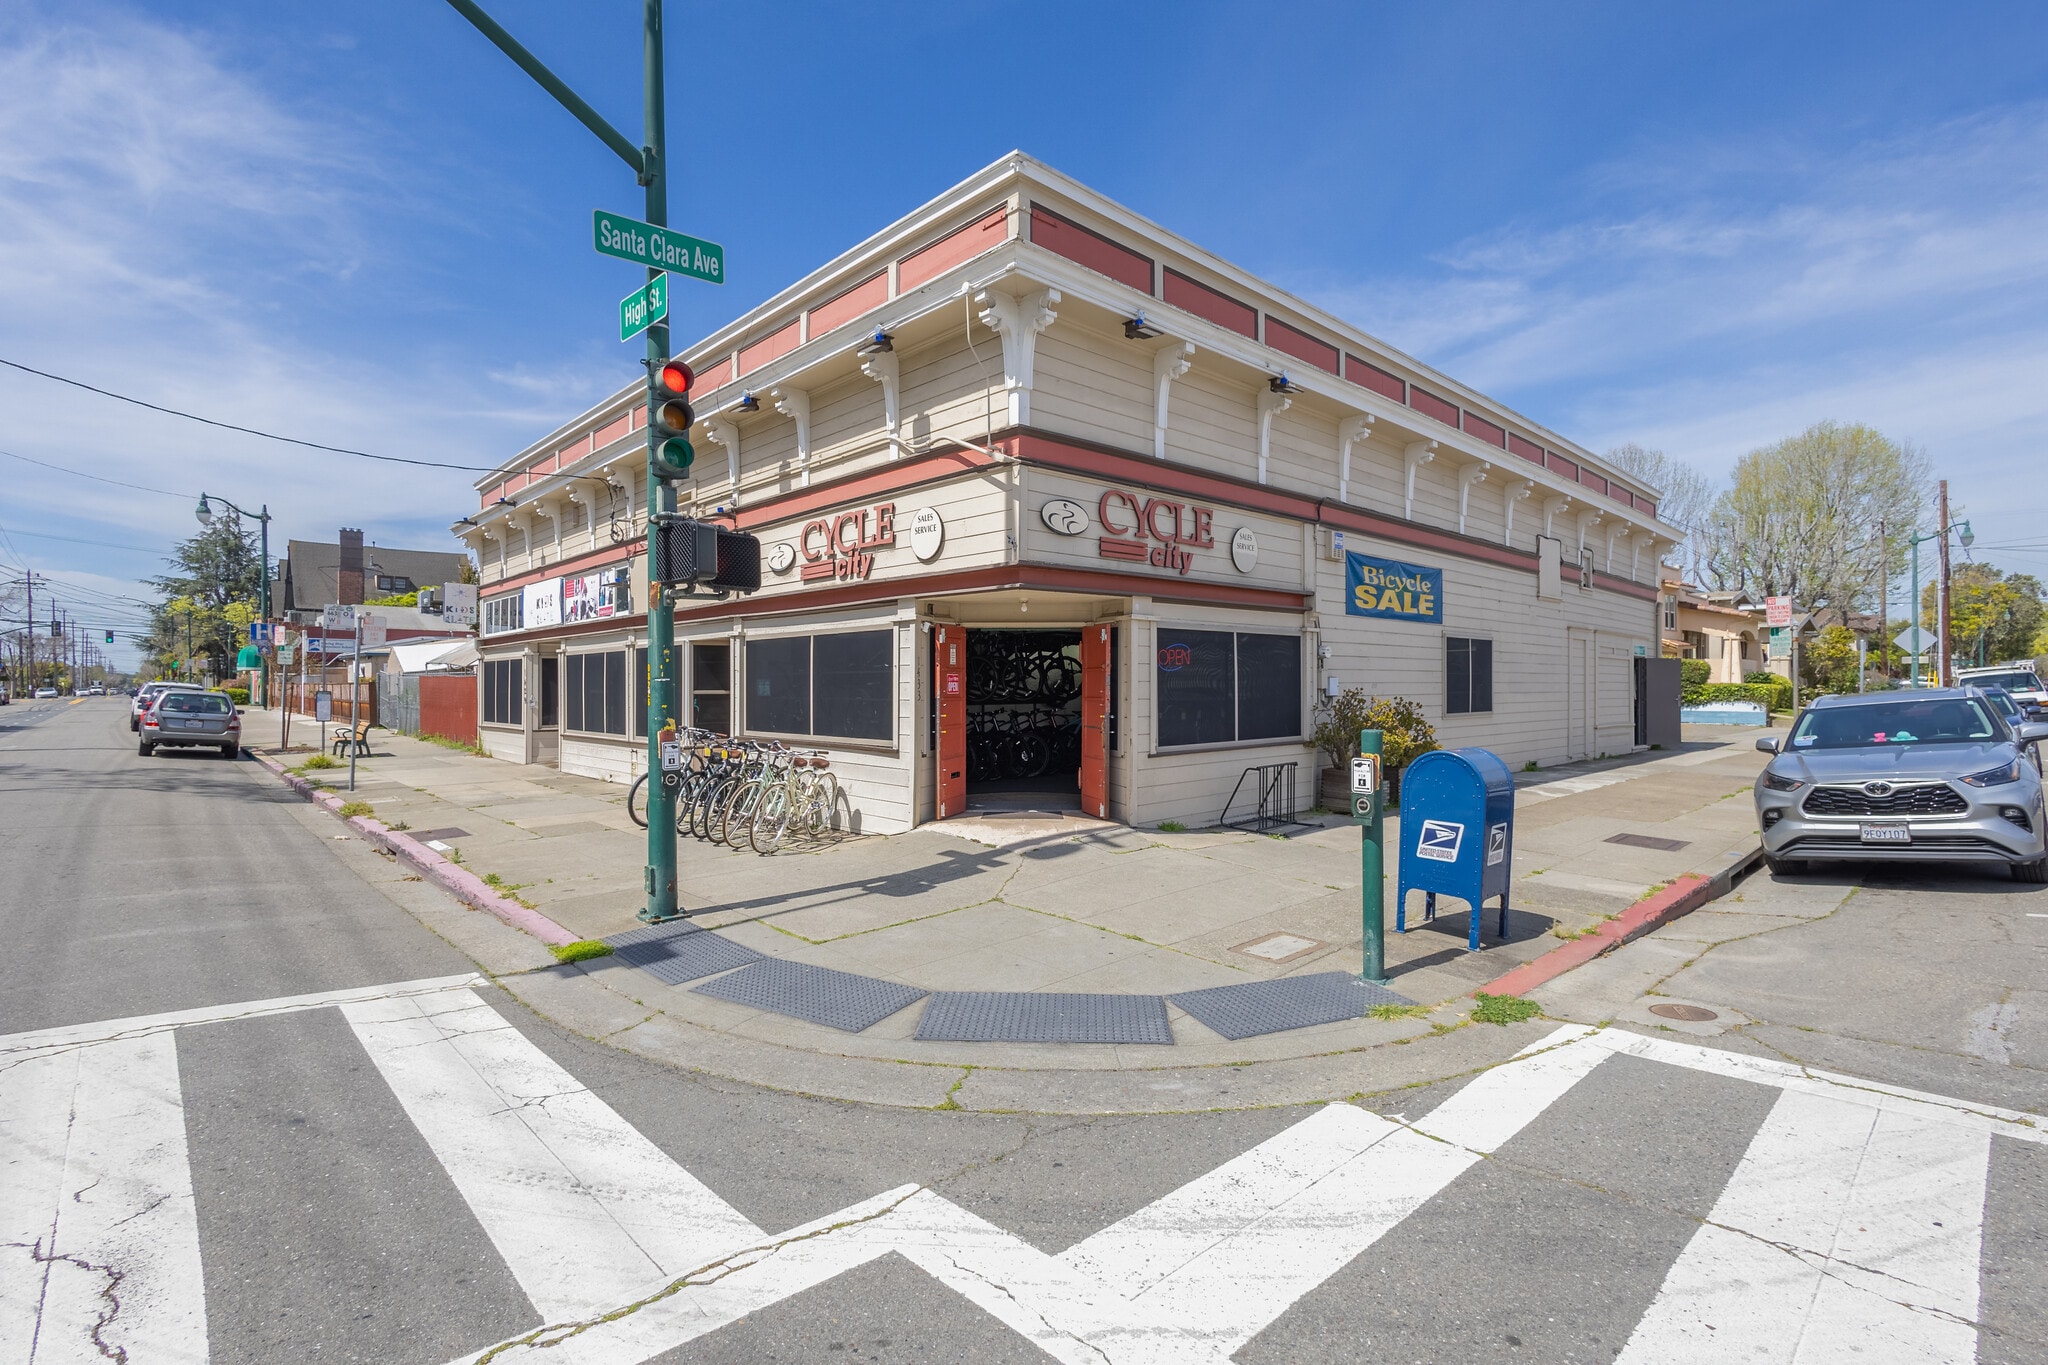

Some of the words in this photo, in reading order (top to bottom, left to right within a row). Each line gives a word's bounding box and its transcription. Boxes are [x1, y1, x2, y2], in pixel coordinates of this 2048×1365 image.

[600, 219, 646, 257] Santa
[650, 233, 690, 269] Clara
[694, 246, 719, 277] Ave
[624, 296, 647, 328] High
[649, 287, 663, 312] St.
[800, 502, 896, 562] CYCLE
[914, 523, 938, 536] SERVICE
[917, 512, 934, 524] SALES
[1099, 489, 1215, 549] CYCLE
[1236, 541, 1255, 553] SERVICE
[1239, 532, 1253, 543] SALES
[835, 550, 874, 579] city
[1150, 541, 1194, 576] city
[1362, 565, 1433, 594] Bicycle
[1354, 584, 1435, 616] SALE
[1158, 648, 1191, 666] OPEN
[948, 681, 960, 693] OPEN
